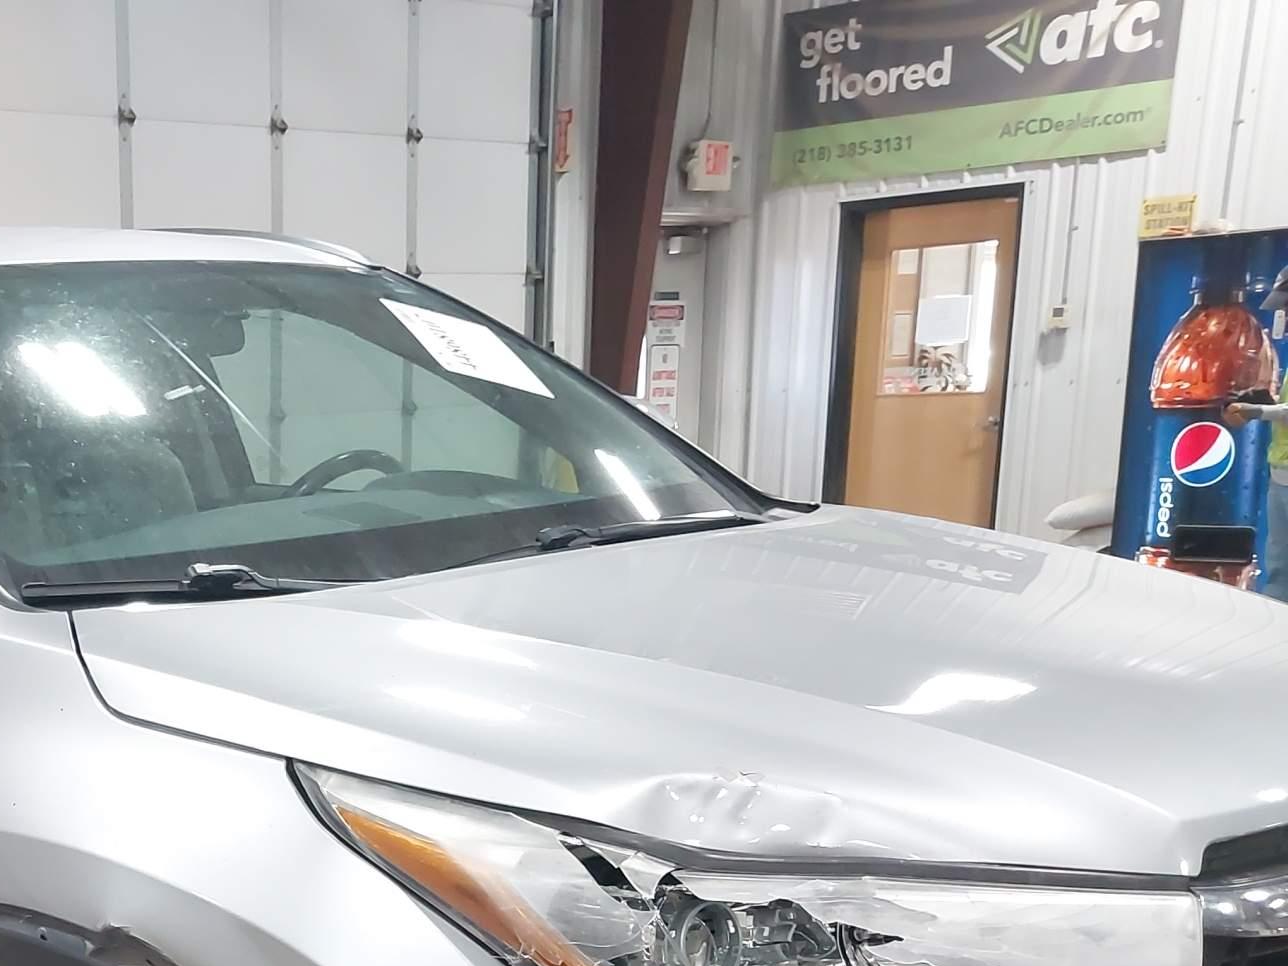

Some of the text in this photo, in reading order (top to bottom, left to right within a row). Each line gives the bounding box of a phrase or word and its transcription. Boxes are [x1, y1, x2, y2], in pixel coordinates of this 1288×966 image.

[799, 18, 862, 69] get
[816, 45, 953, 103] floored
[998, 108, 1145, 139] AFCDealer.com
[792, 135, 912, 166] (218) 385-3131
[1156, 477, 1174, 538] pepsi
